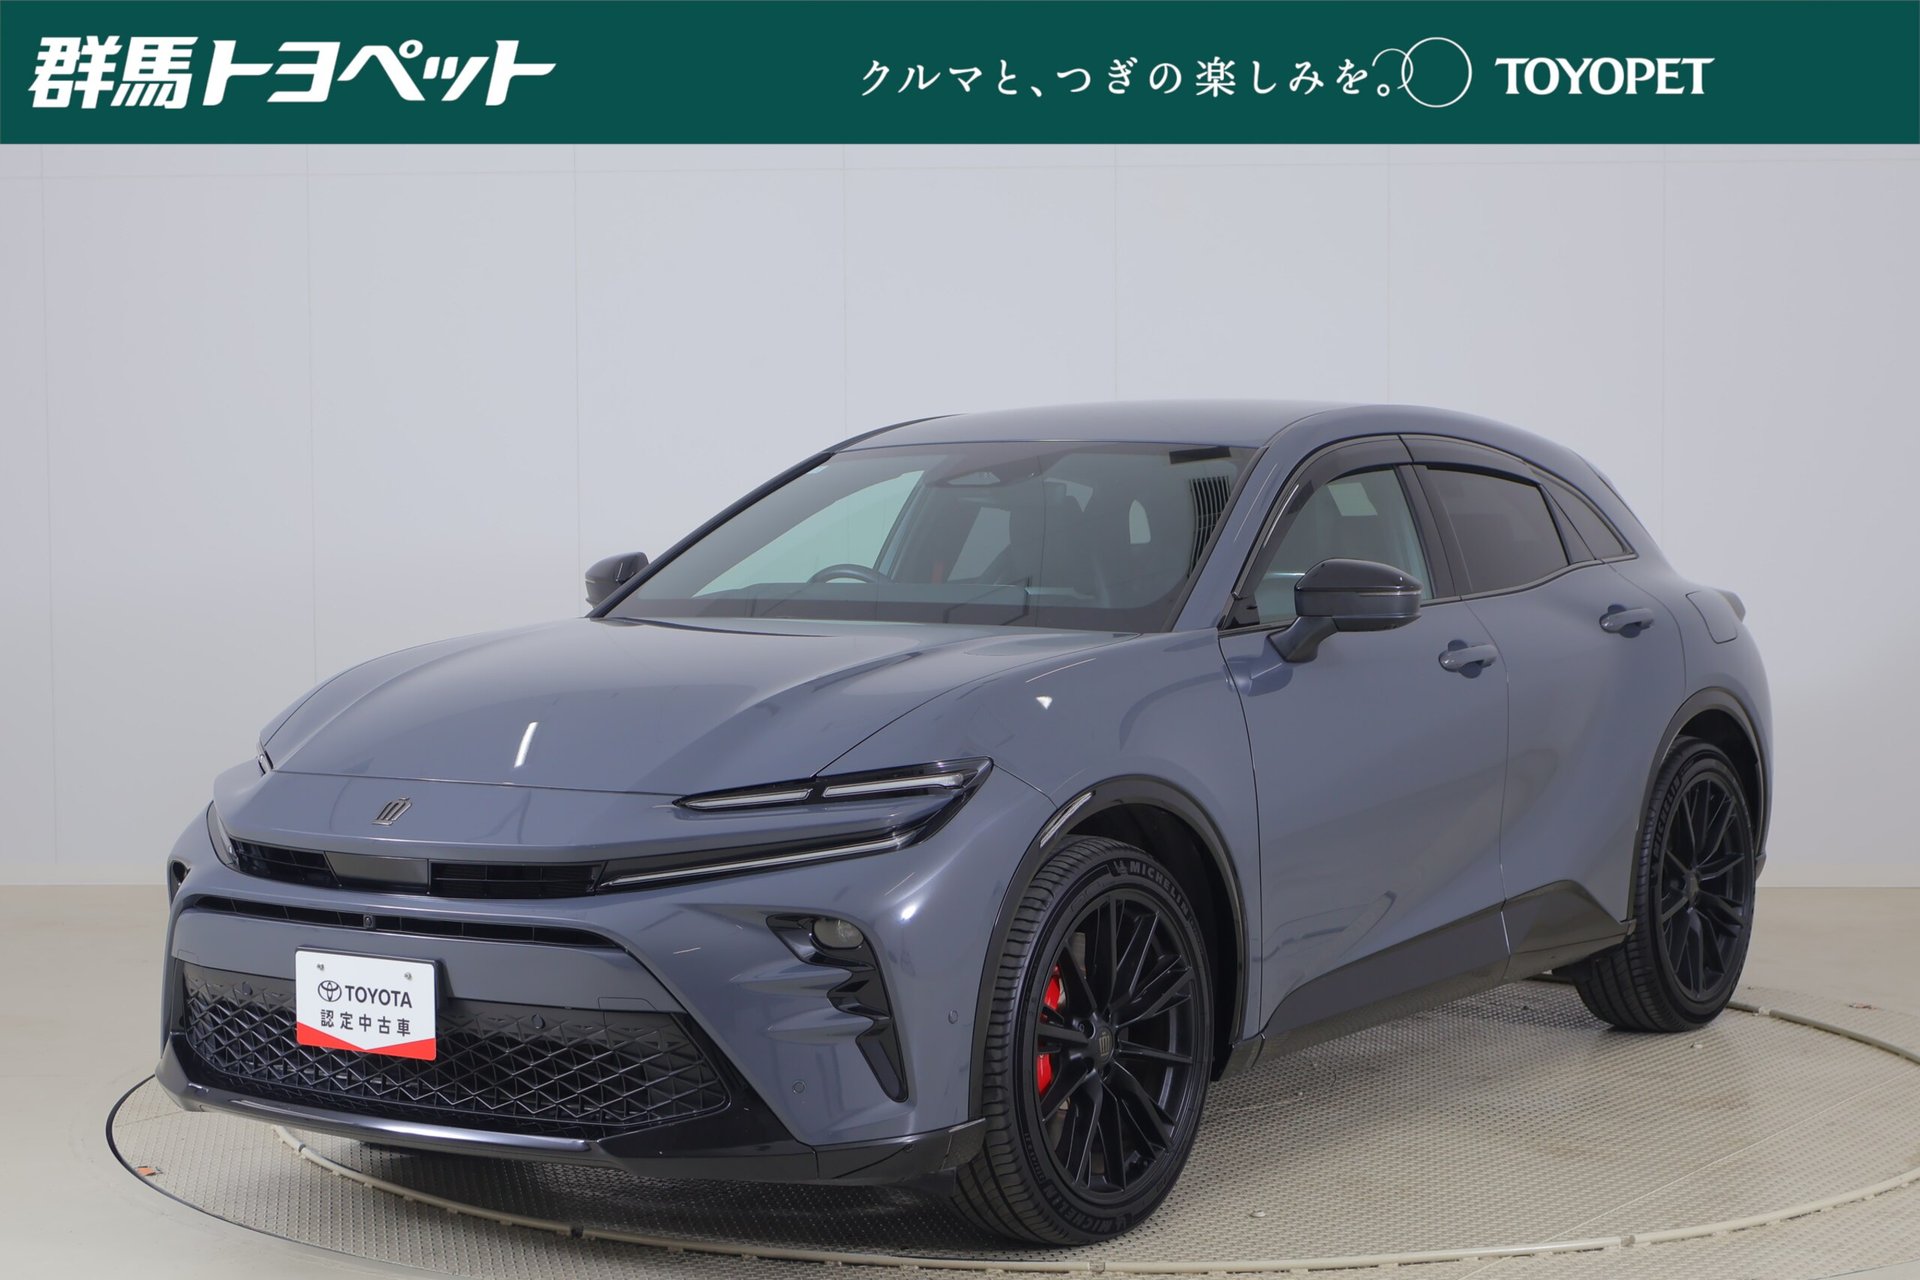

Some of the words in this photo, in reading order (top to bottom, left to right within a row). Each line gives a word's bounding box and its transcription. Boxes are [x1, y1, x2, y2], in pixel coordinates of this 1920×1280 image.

[1653, 775, 1681, 859] MICHELIN
[1129, 860, 1190, 916] MICHELIN
[344, 984, 413, 1009] TOYOTA
[320, 1008, 411, 1038] 認定中古車
[1042, 1182, 1113, 1234] MICHELIN
